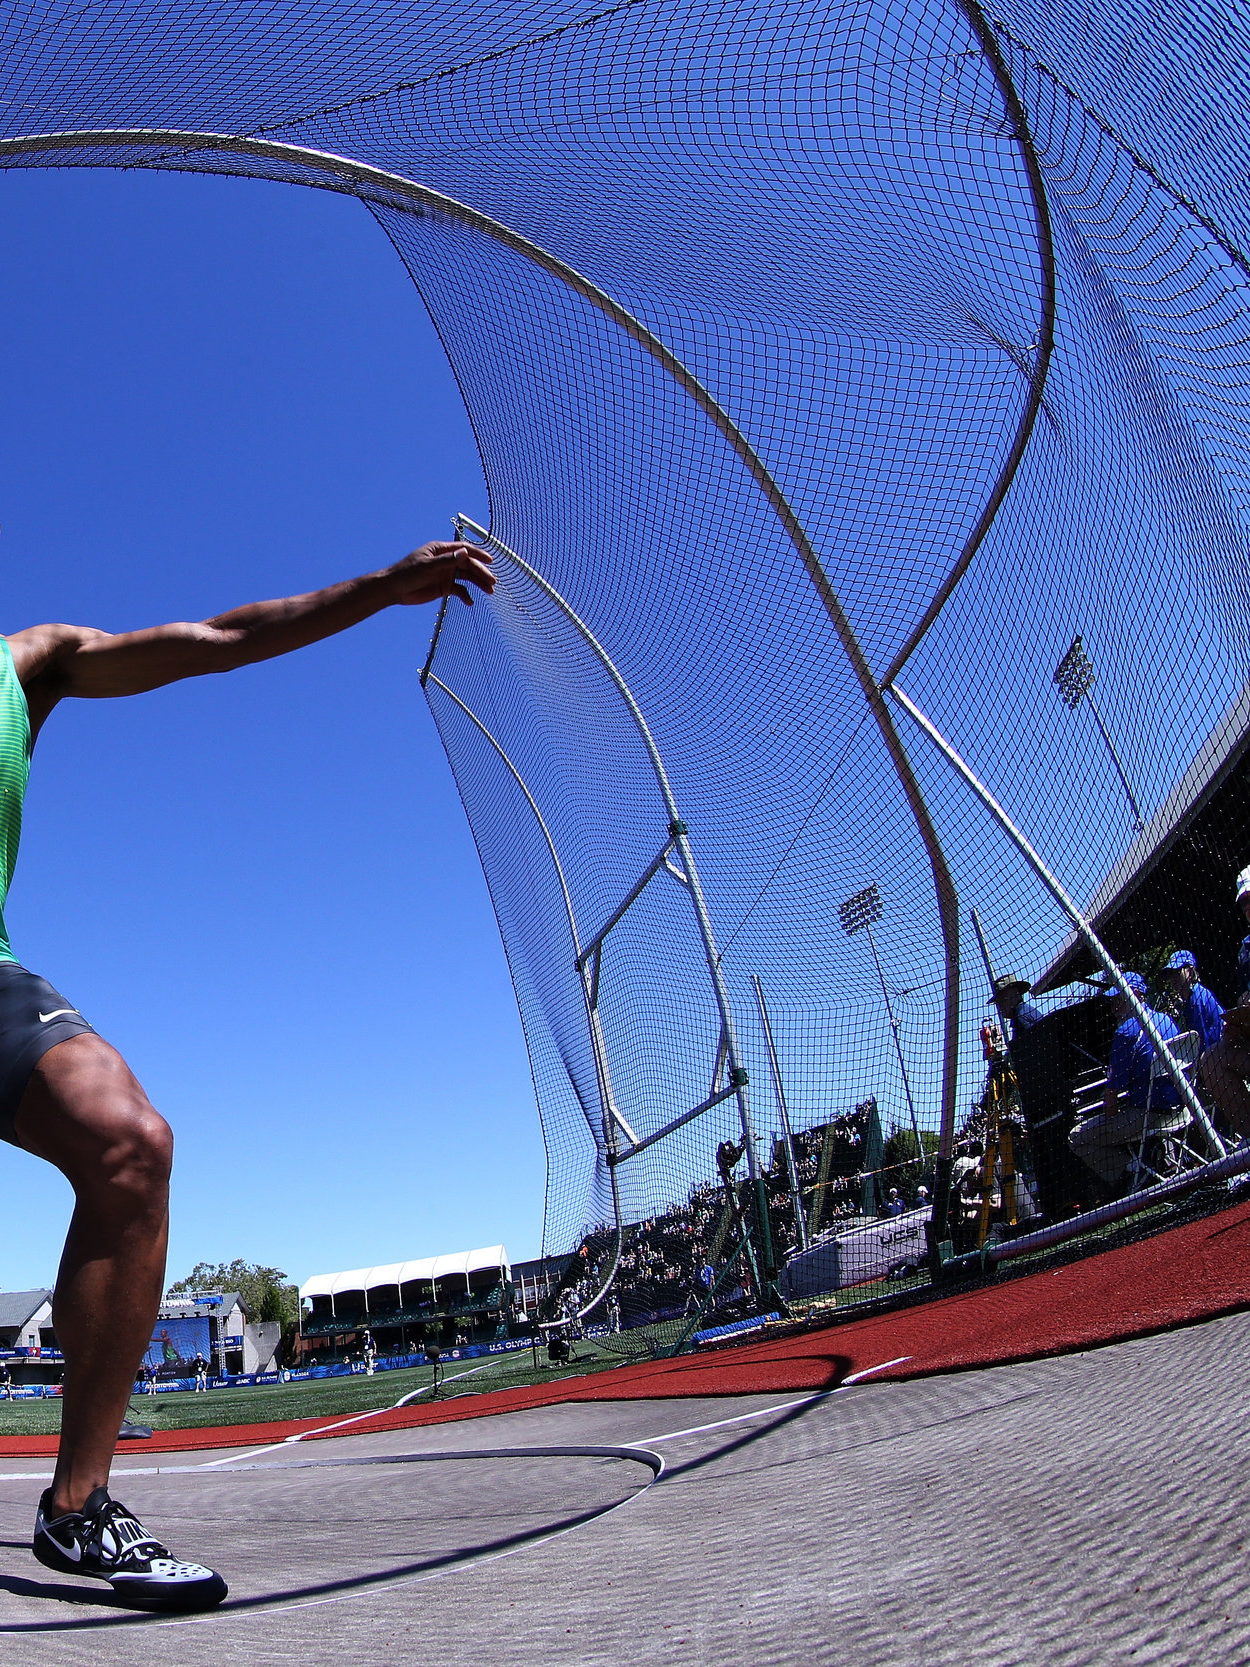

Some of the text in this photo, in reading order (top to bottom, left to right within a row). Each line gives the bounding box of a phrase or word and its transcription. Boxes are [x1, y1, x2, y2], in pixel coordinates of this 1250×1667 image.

[489, 1343, 504, 1352] U.S.
[505, 1336, 541, 1349] OLYMPC
[117, 1520, 153, 1545] NIK
